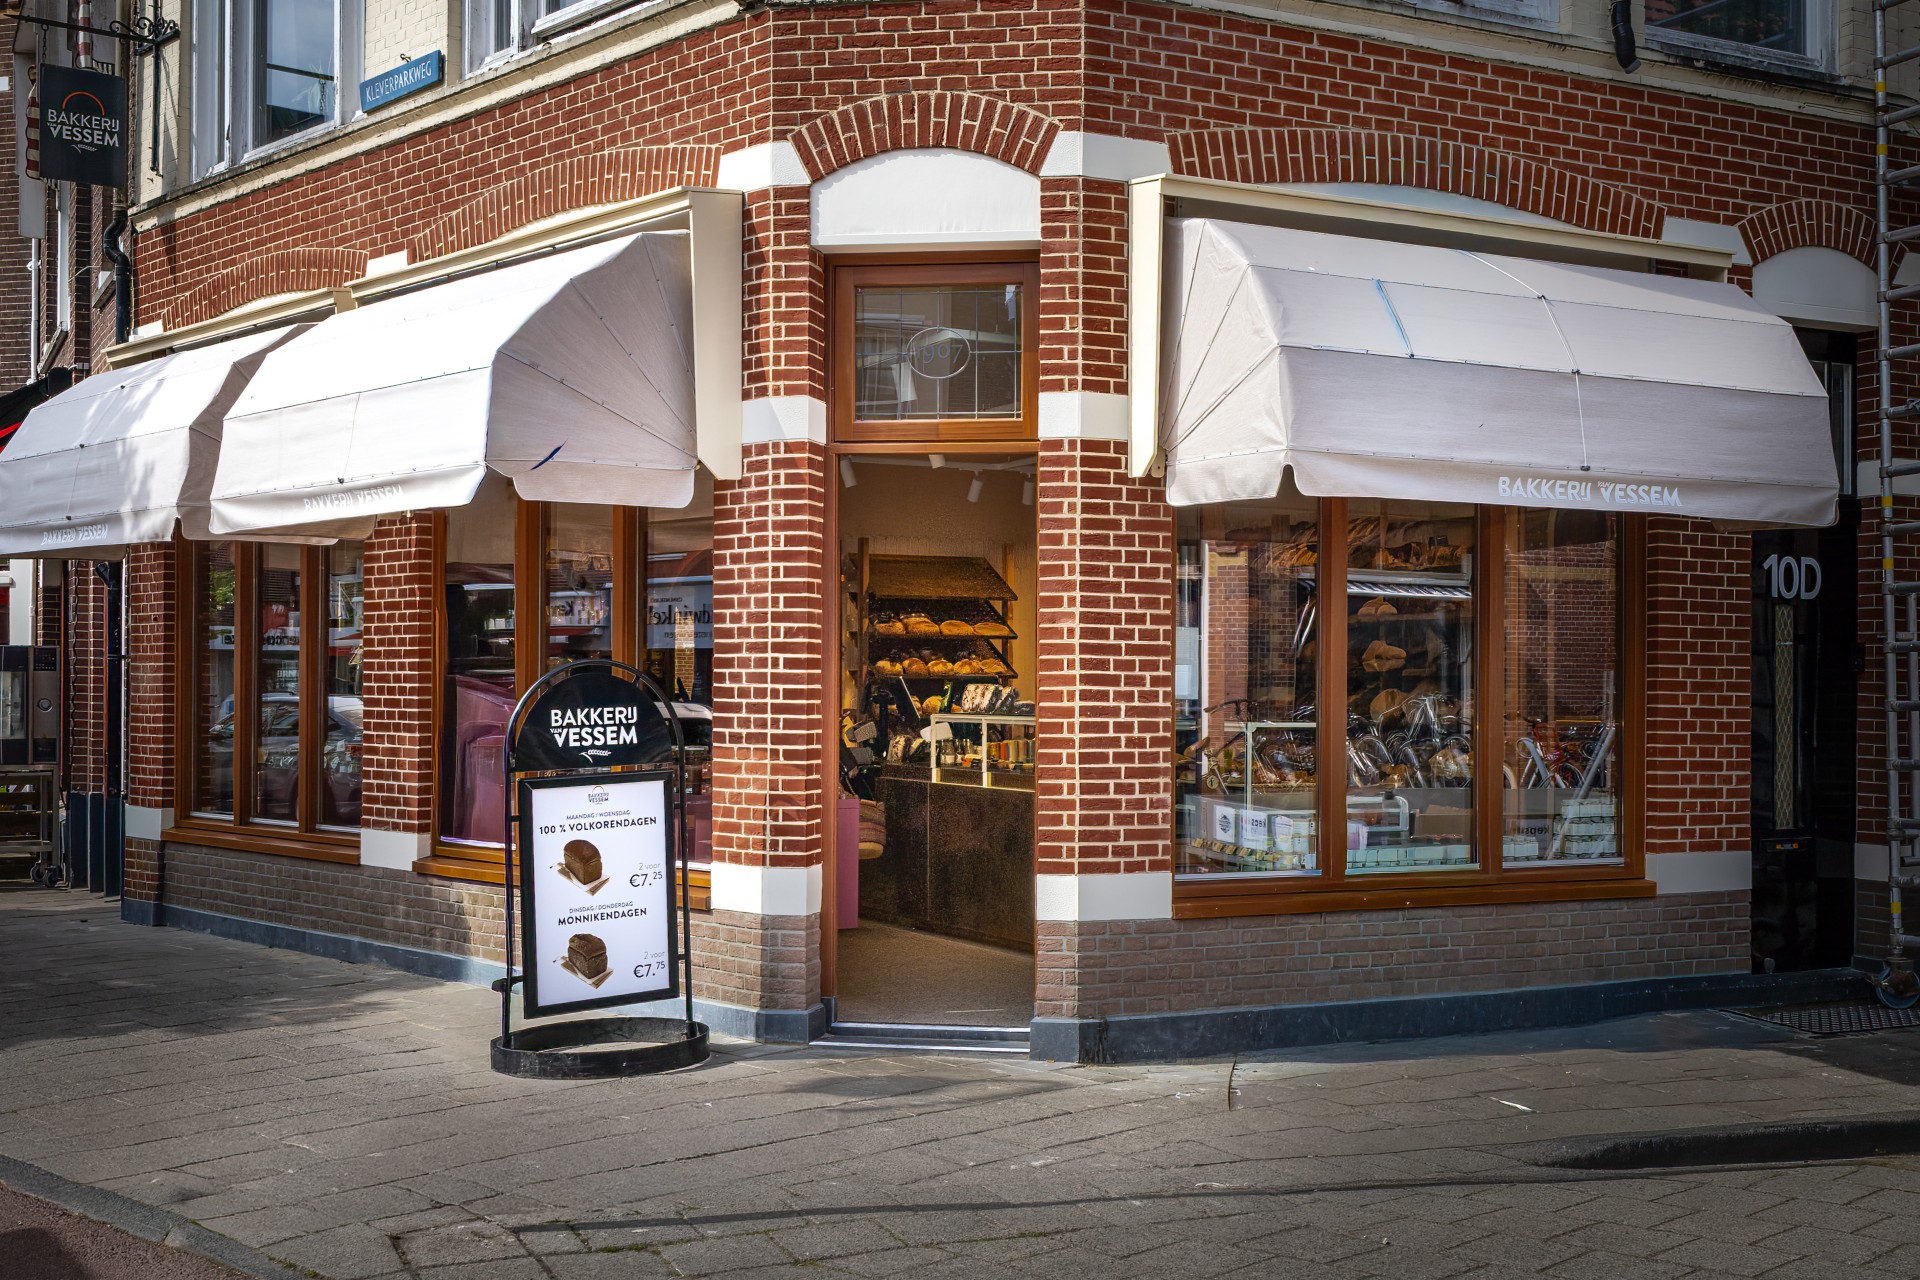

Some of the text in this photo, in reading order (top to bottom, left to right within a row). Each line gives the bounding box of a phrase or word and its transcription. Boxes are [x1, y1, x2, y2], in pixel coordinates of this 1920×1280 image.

[365, 60, 432, 103] KLEVERPARKWEG
[48, 108, 119, 132] BAKKERIJ
[49, 124, 119, 147] VESSEM
[1498, 476, 1592, 502] BAKKERIJ
[1600, 482, 1683, 507] VESSEM
[1763, 553, 1822, 600] 10D
[550, 706, 638, 727] BAKKERIJ
[553, 725, 638, 748] VESSEM
[566, 812, 595, 820] MAANDAG
[599, 809, 631, 817] WOENSDAG
[539, 825, 556, 835] 100
[569, 816, 657, 832] VOLKORENDAGEN
[639, 862, 644, 871] 2
[558, 907, 647, 926] MONNIKENDAGEN
[569, 905, 594, 914] DINSDAG
[598, 901, 634, 910] DONDERDAG
[643, 951, 649, 960] 2
